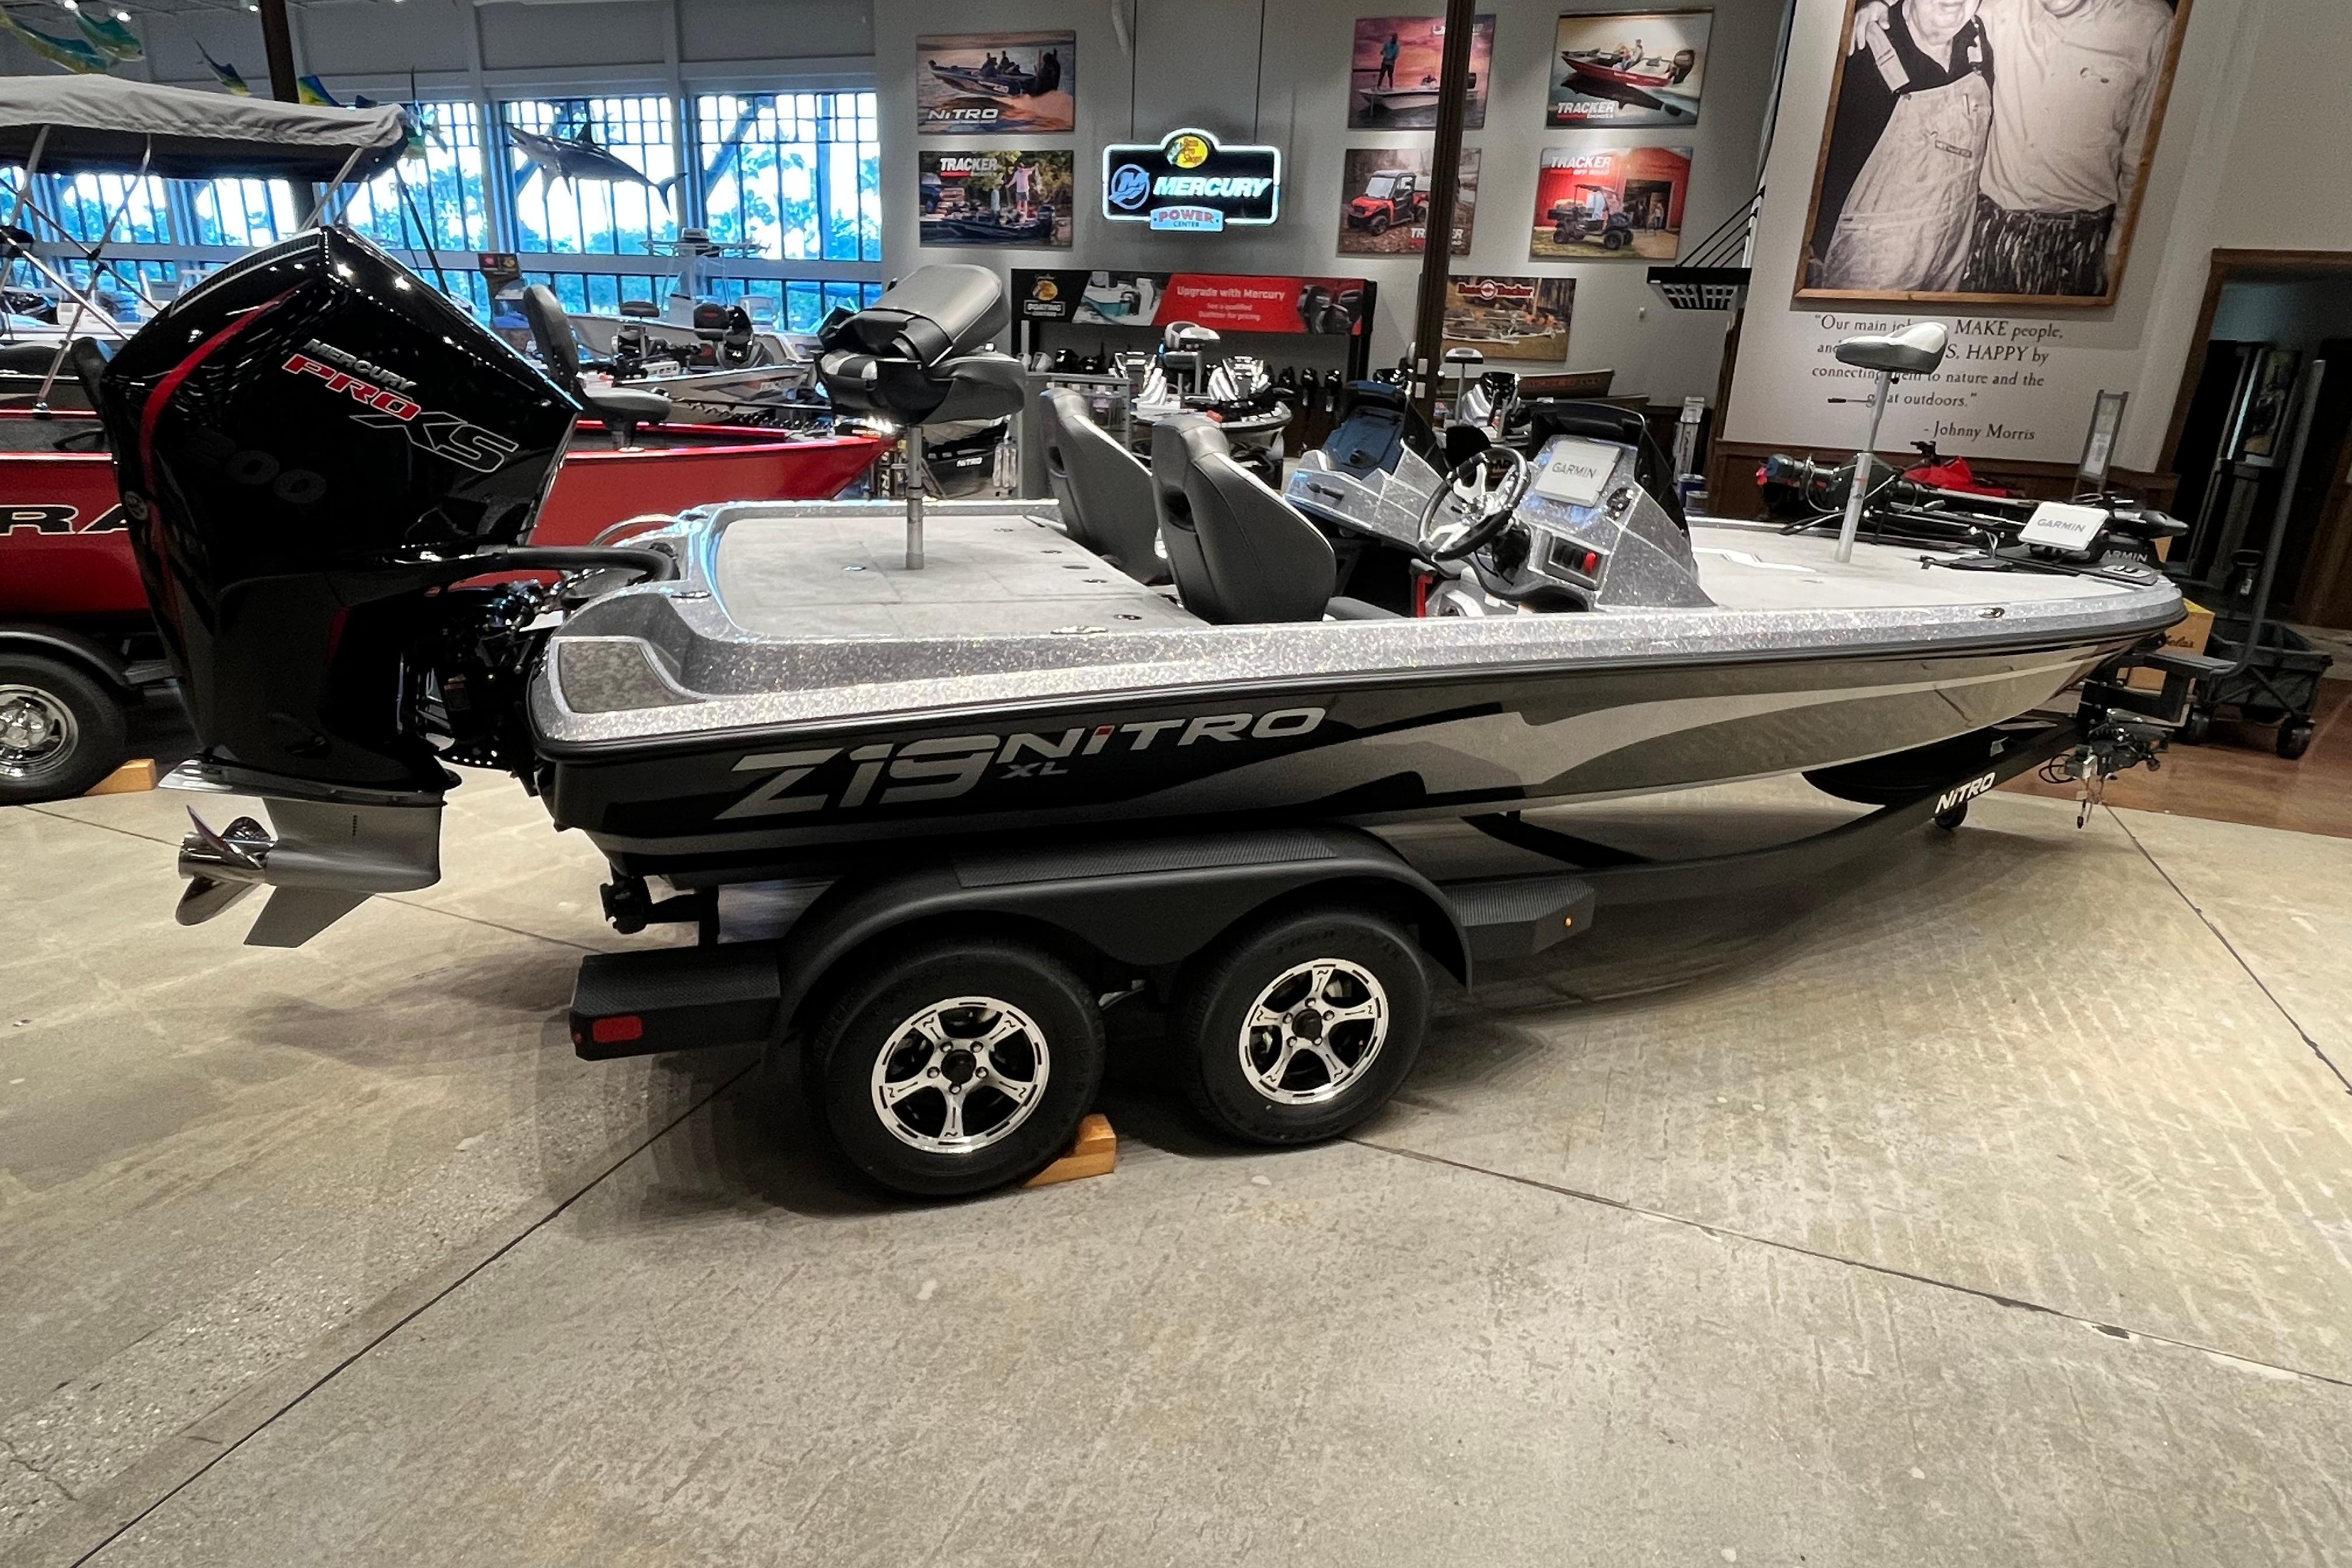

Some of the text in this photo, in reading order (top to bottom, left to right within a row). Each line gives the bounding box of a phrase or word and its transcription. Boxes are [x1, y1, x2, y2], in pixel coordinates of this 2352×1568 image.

[1557, 102, 1615, 113] TRACKER
[940, 158, 998, 171] TRACKER
[1551, 156, 1612, 168] TRACKER
[1153, 176, 1273, 197] MERCURY
[1158, 209, 1214, 223] POWER
[1177, 286, 1285, 301] Upgrade with Mercury
[1854, 320, 1887, 331] main
[1955, 318, 2008, 336] MAKE
[303, 338, 418, 390] MERCURY
[1966, 344, 2029, 361] HAPPY
[2032, 346, 2049, 367] by
[1946, 373, 1988, 384] nature
[1992, 371, 2018, 385] and
[2023, 372, 2045, 386] the
[282, 354, 421, 421] PRO
[1866, 393, 1899, 408] gat
[1933, 420, 1982, 442] Johnny
[1986, 424, 2036, 440] Morris
[349, 411, 519, 473] XS
[1552, 462, 1597, 479] GARMIN
[2037, 518, 2086, 533] GARMIN
[2102, 549, 2148, 562] ARMIN
[717, 734, 1000, 820] Z19
[1000, 761, 1069, 779] XL
[1935, 772, 1996, 814] NITRO
